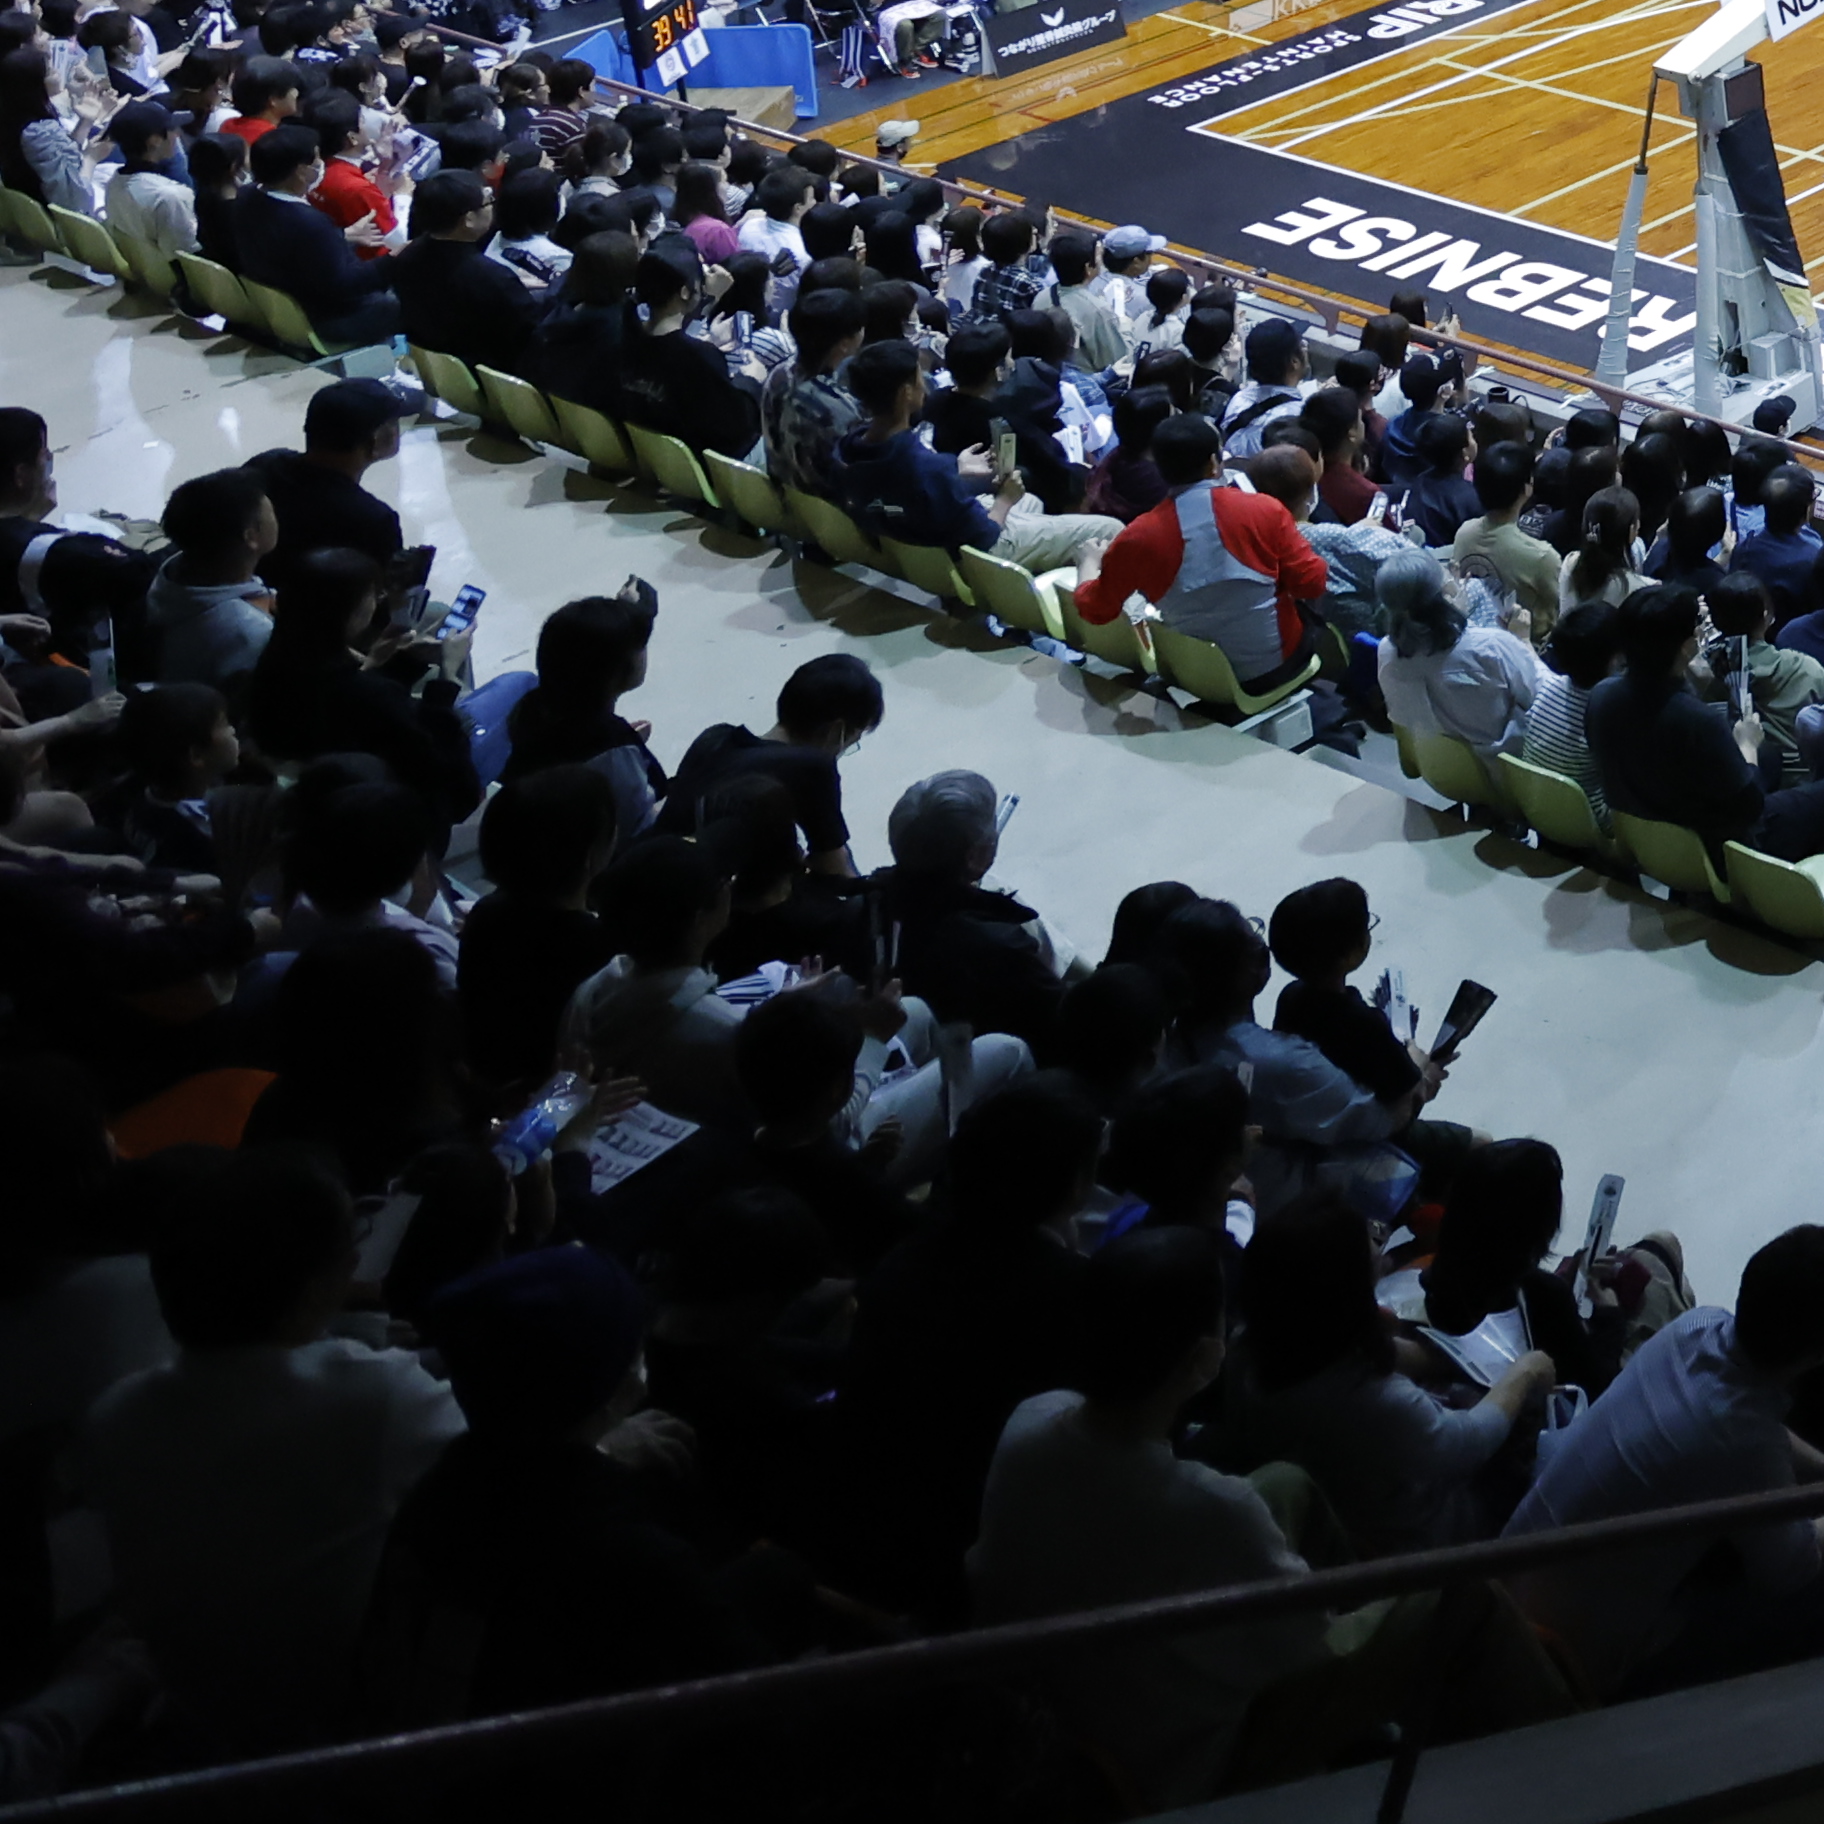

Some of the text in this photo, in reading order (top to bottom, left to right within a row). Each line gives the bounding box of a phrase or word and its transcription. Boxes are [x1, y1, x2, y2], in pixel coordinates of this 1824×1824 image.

[651, 14, 673, 53] 39
[1146, 29, 1353, 104] MAINTENANCE
[1240, 196, 1698, 353] REBNISE
